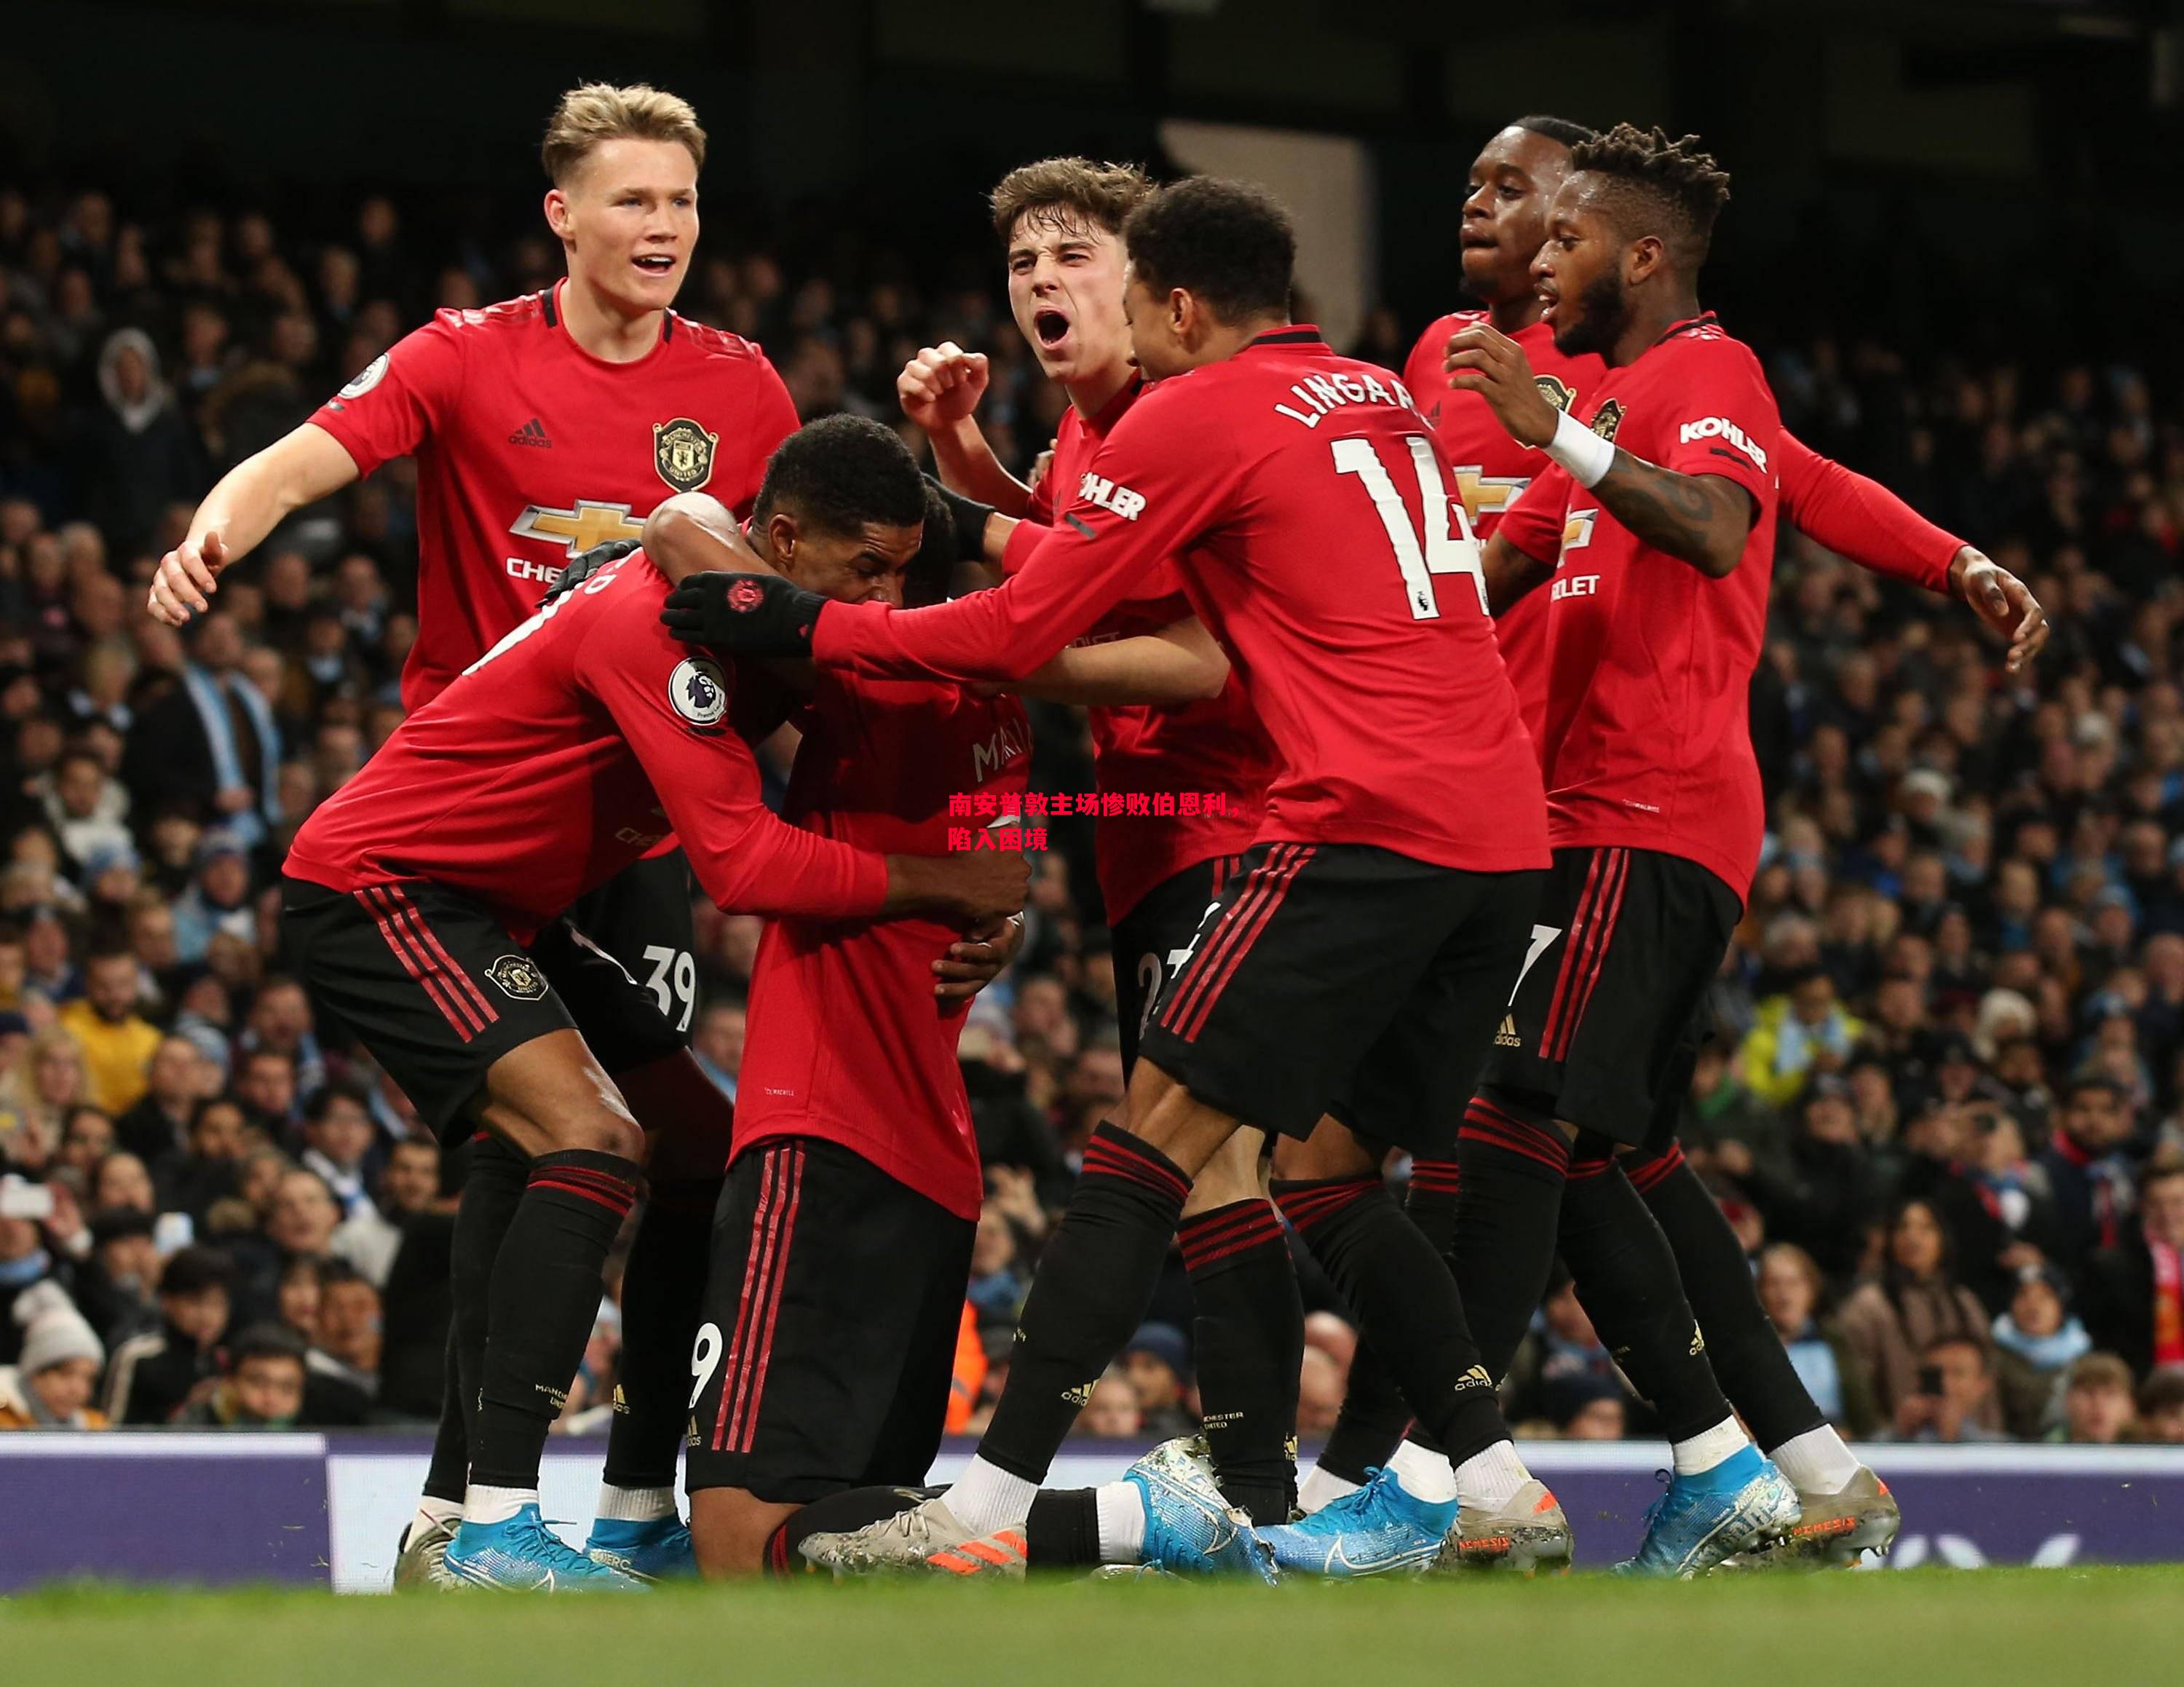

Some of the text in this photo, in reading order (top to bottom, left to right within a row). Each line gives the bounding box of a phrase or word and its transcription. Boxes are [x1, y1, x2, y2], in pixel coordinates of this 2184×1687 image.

[508, 435, 552, 449] adidas
[1679, 416, 1768, 474] KOHLER
[1330, 436, 1490, 620] 14
[643, 944, 696, 1032] 39
[688, 1322, 723, 1409] 9
[1458, 1536, 1511, 1552] NEMESIS
[1793, 1515, 1856, 1536] NEMESIS
